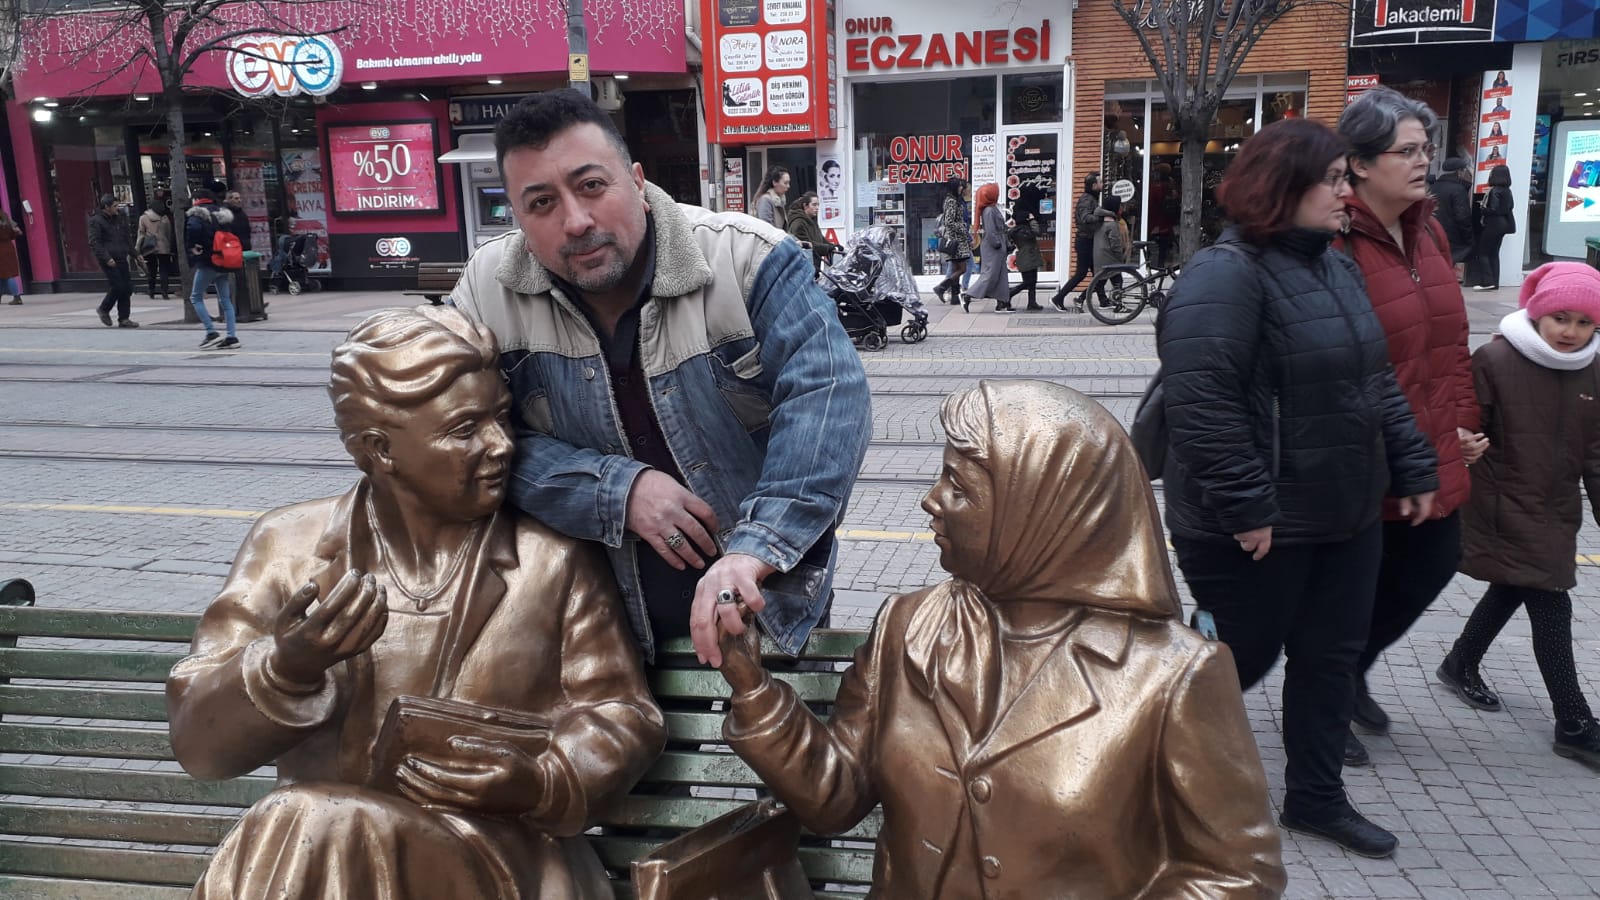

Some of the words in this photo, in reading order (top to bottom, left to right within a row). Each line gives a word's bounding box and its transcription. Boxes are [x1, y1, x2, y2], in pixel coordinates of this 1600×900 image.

[1388, 5, 1461, 24] akademi
[845, 16, 892, 34] ONUR
[779, 36, 804, 46] NORA
[846, 19, 1050, 71] ECZANESİ
[229, 36, 336, 95] eve
[356, 57, 393, 69] Bakımlı
[394, 56, 433, 67] olmanın
[433, 53, 459, 65] akıllı
[459, 52, 482, 66] yolu
[370, 128, 390, 138] eve
[974, 135, 995, 143] SGK
[890, 134, 963, 162] ONUR
[974, 144, 994, 154] İLAÇ
[353, 143, 411, 184] %50
[888, 157, 969, 184] ECZANESİ
[357, 192, 415, 209] İNDİRİM
[378, 238, 410, 255] eve
